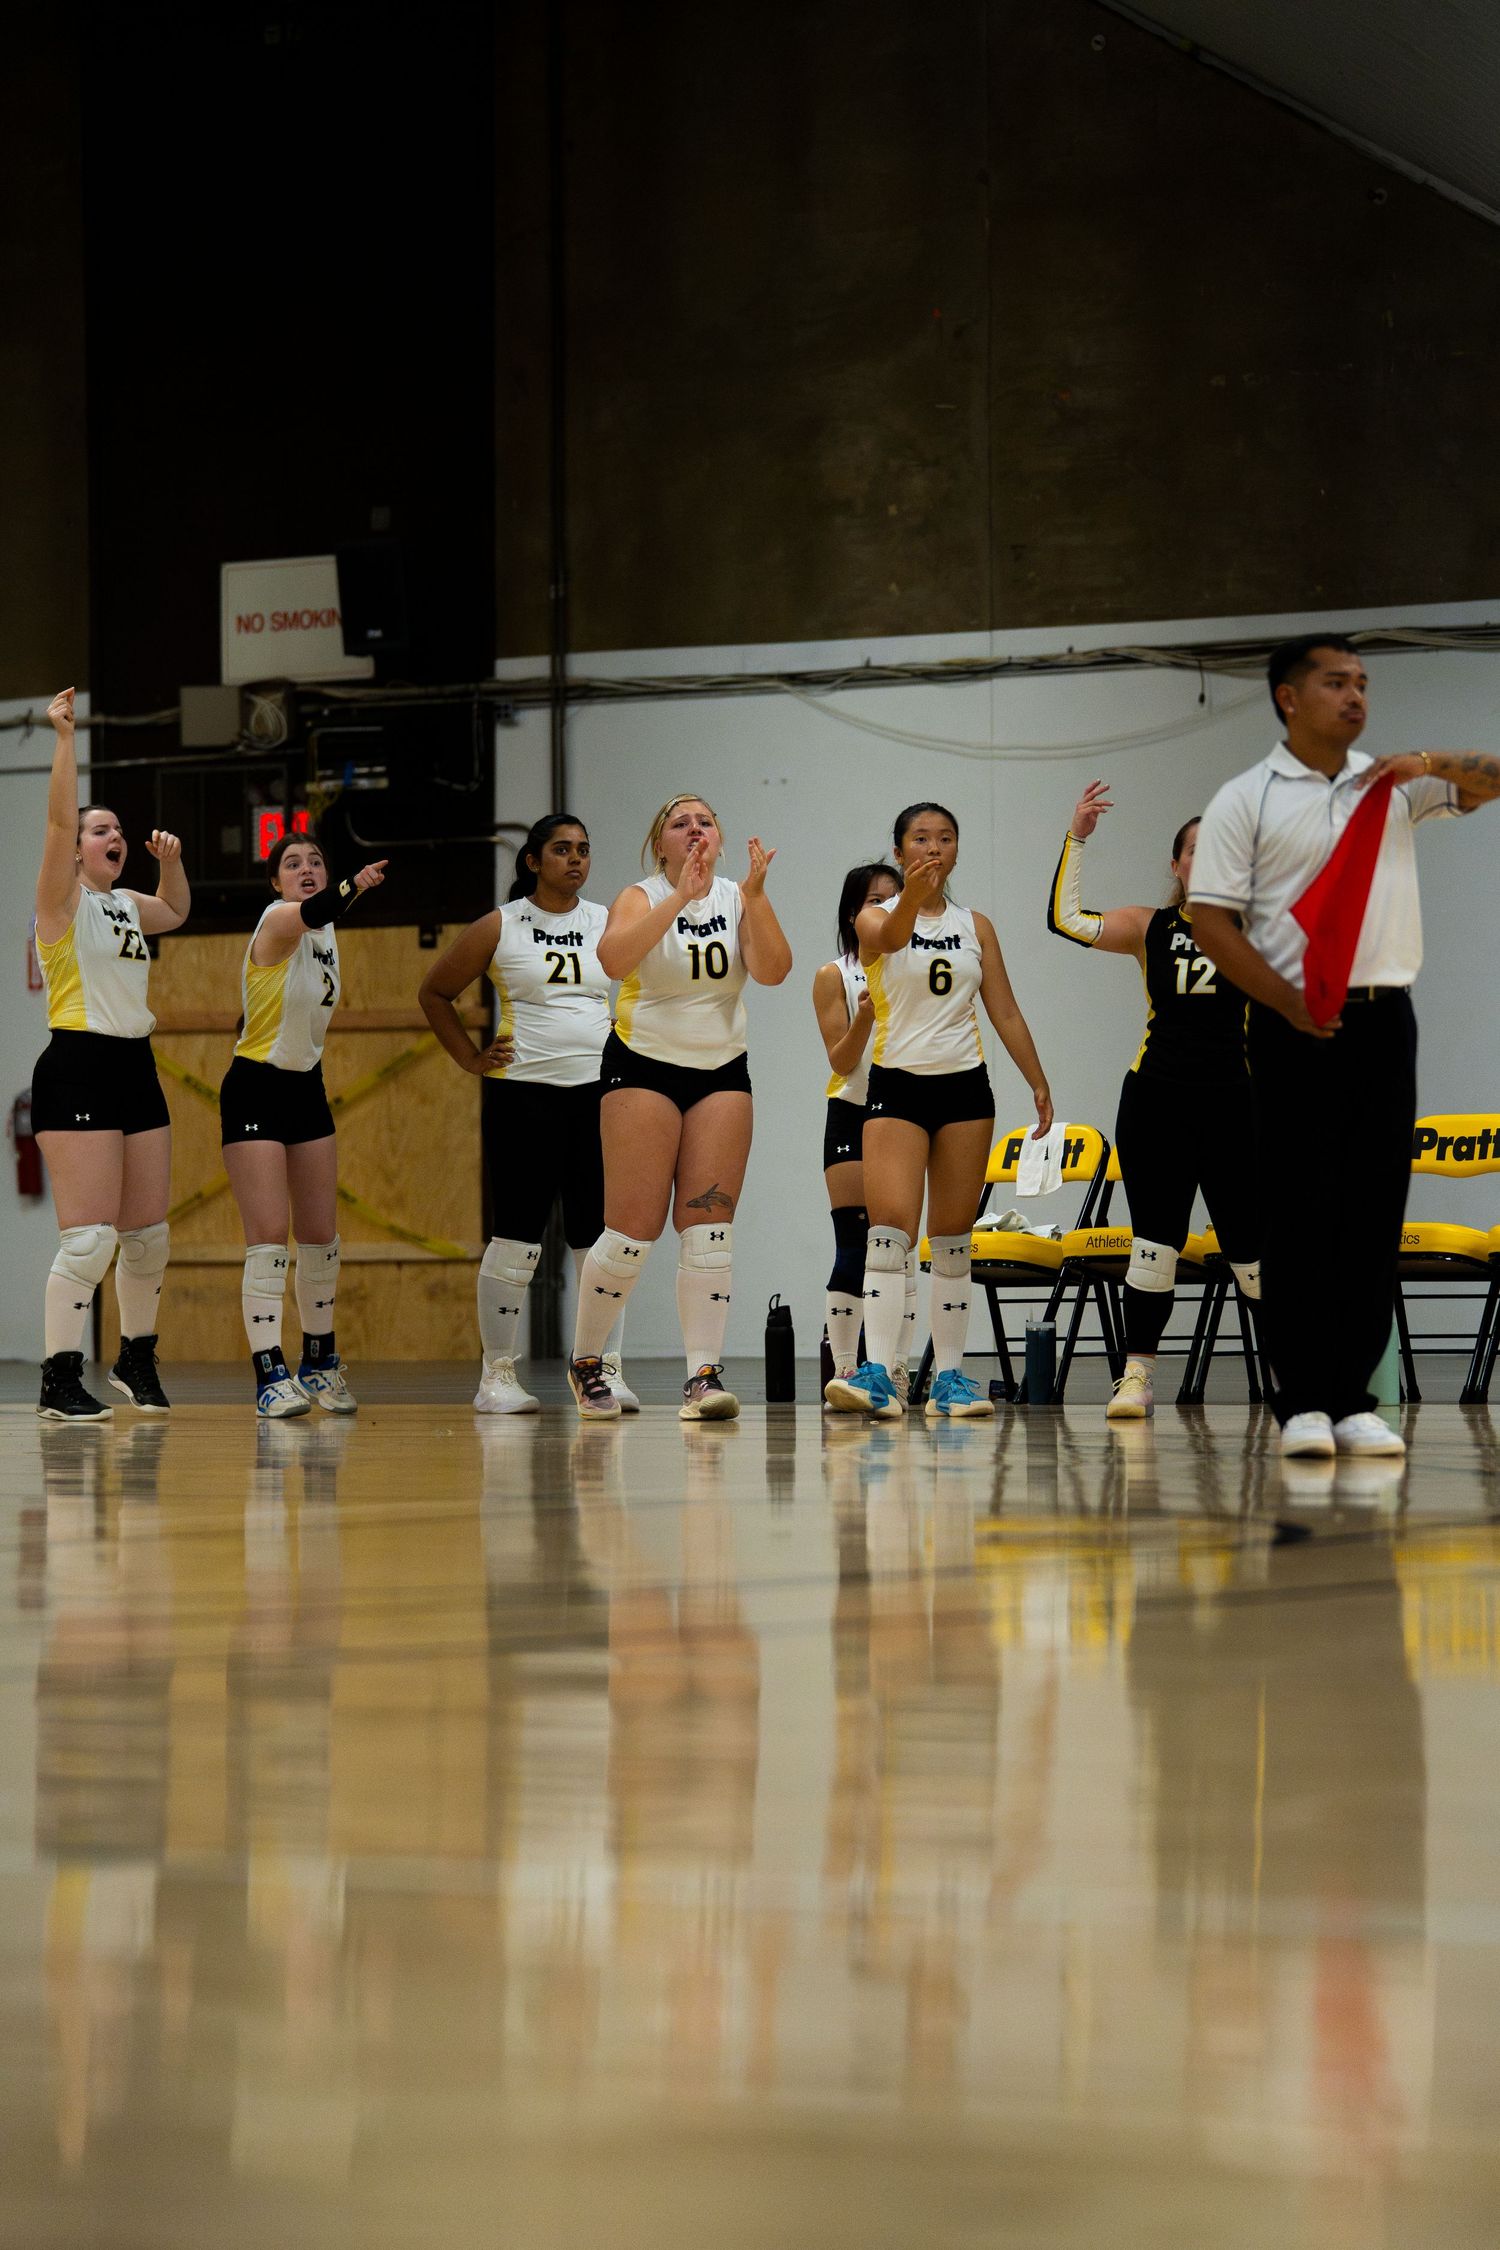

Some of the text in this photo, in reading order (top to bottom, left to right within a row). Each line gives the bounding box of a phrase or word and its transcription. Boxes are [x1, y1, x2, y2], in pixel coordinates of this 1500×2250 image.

[236, 613, 265, 635] NO
[270, 607, 343, 633] SMOKIN
[533, 928, 584, 947] Pratt
[677, 914, 727, 938] Pratt
[911, 932, 961, 950] Pratt
[545, 951, 582, 985] 21
[687, 940, 729, 980] 10
[1174, 956, 1217, 995] 12
[929, 958, 953, 996] 6
[1002, 1137, 1085, 1169] Ptt
